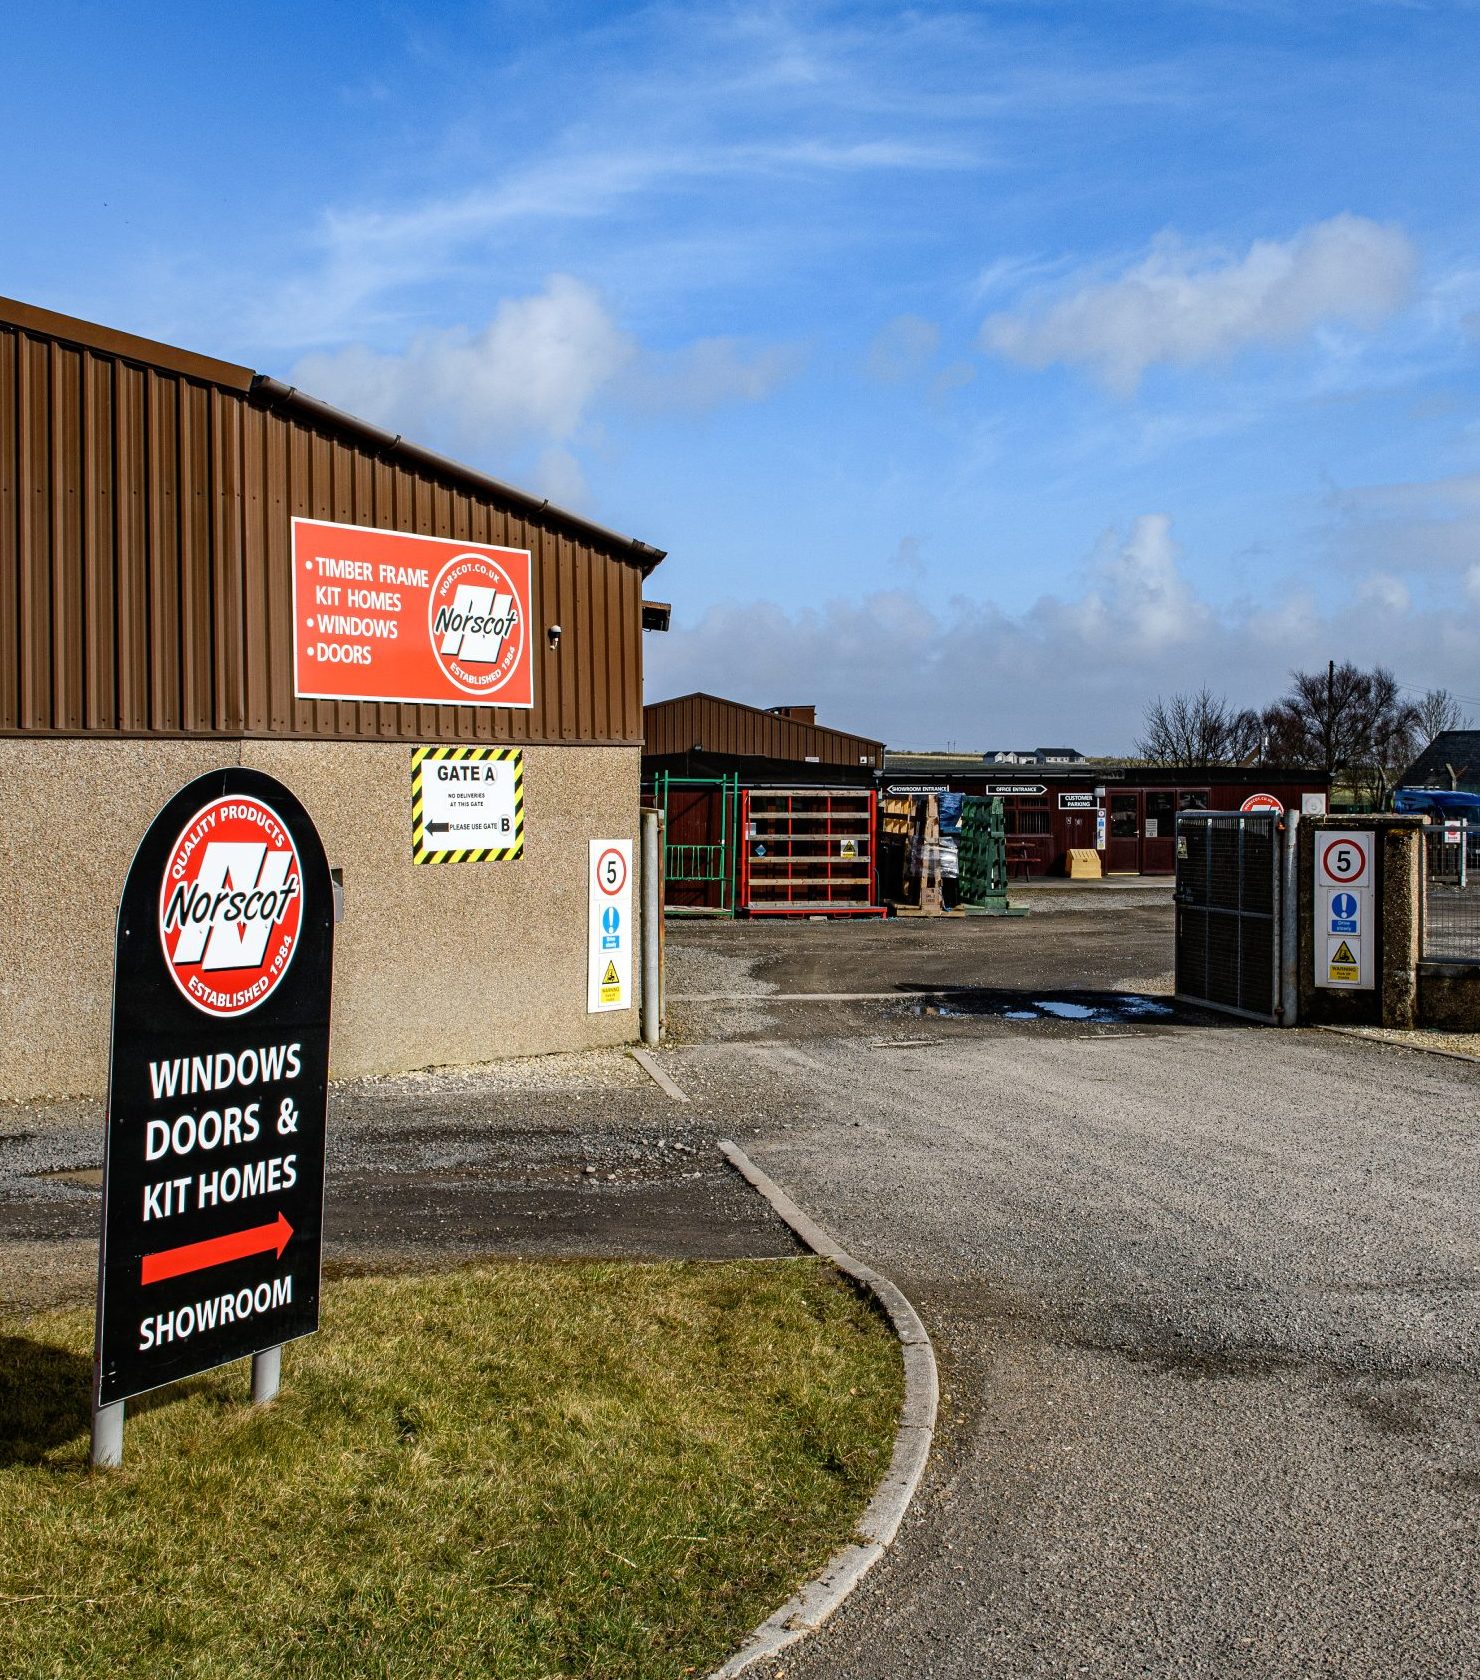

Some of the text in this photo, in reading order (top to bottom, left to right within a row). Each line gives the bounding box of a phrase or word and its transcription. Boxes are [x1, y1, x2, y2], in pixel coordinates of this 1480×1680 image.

[315, 557, 429, 588] TIMBER FRAME
[440, 564, 500, 596] NORSCOT.CO.UK
[316, 586, 402, 612] KIT HOMES
[317, 614, 398, 639] WINDOWS
[435, 607, 517, 637] Norscot
[317, 643, 372, 665] DOORS
[450, 646, 515, 685] ESTABLISHED 1984
[437, 765, 495, 781] GATE A
[501, 818, 510, 832] B
[172, 805, 285, 879] QUALITY PRODUCTS
[606, 861, 617, 884] 5
[1336, 850, 1351, 872] 5
[165, 877, 296, 929] Norscot
[188, 935, 292, 1008] ESTABLISHED 1984
[149, 1043, 302, 1099] WINDOWS
[146, 1098, 299, 1161] DOORS &
[143, 1154, 297, 1221] KIT HOMES
[139, 1276, 292, 1351] SHOWROOM
